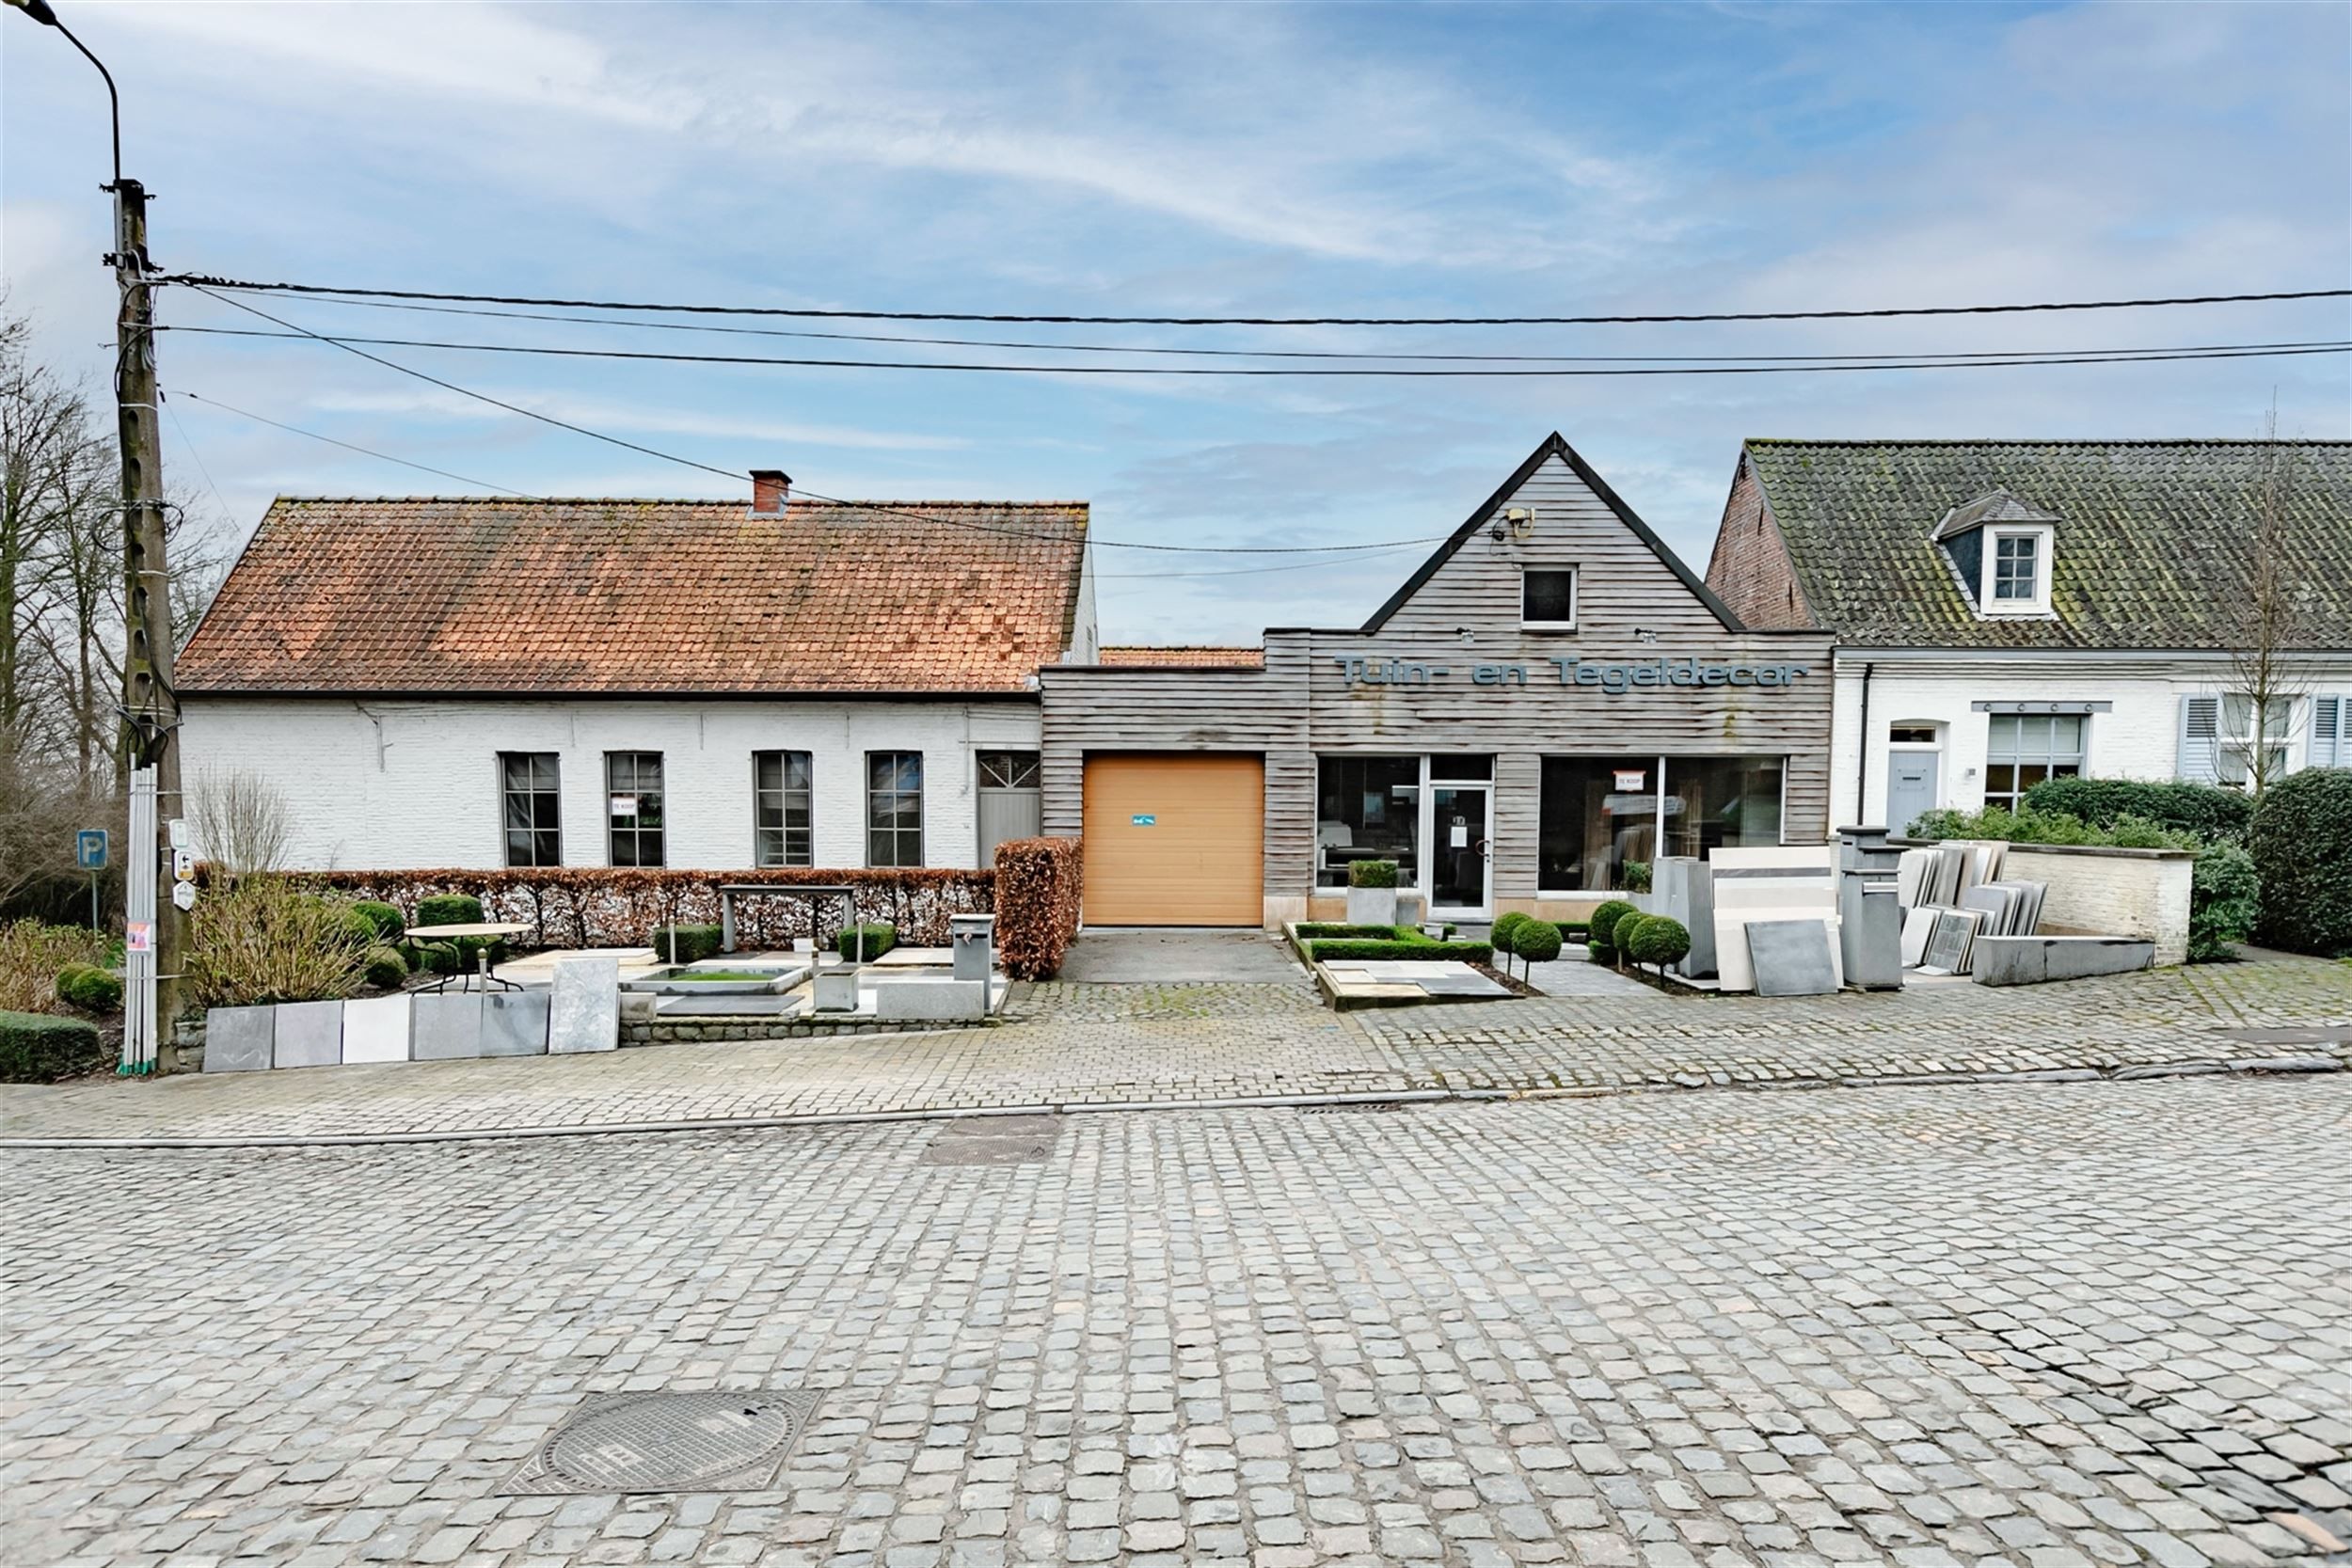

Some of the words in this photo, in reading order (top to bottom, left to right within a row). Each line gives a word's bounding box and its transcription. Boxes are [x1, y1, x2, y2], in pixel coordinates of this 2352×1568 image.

[1335, 656, 1450, 685] Tuin-
[1473, 663, 1527, 685] en
[1550, 657, 1808, 694] Tegeldecor
[82, 837, 103, 863] P
